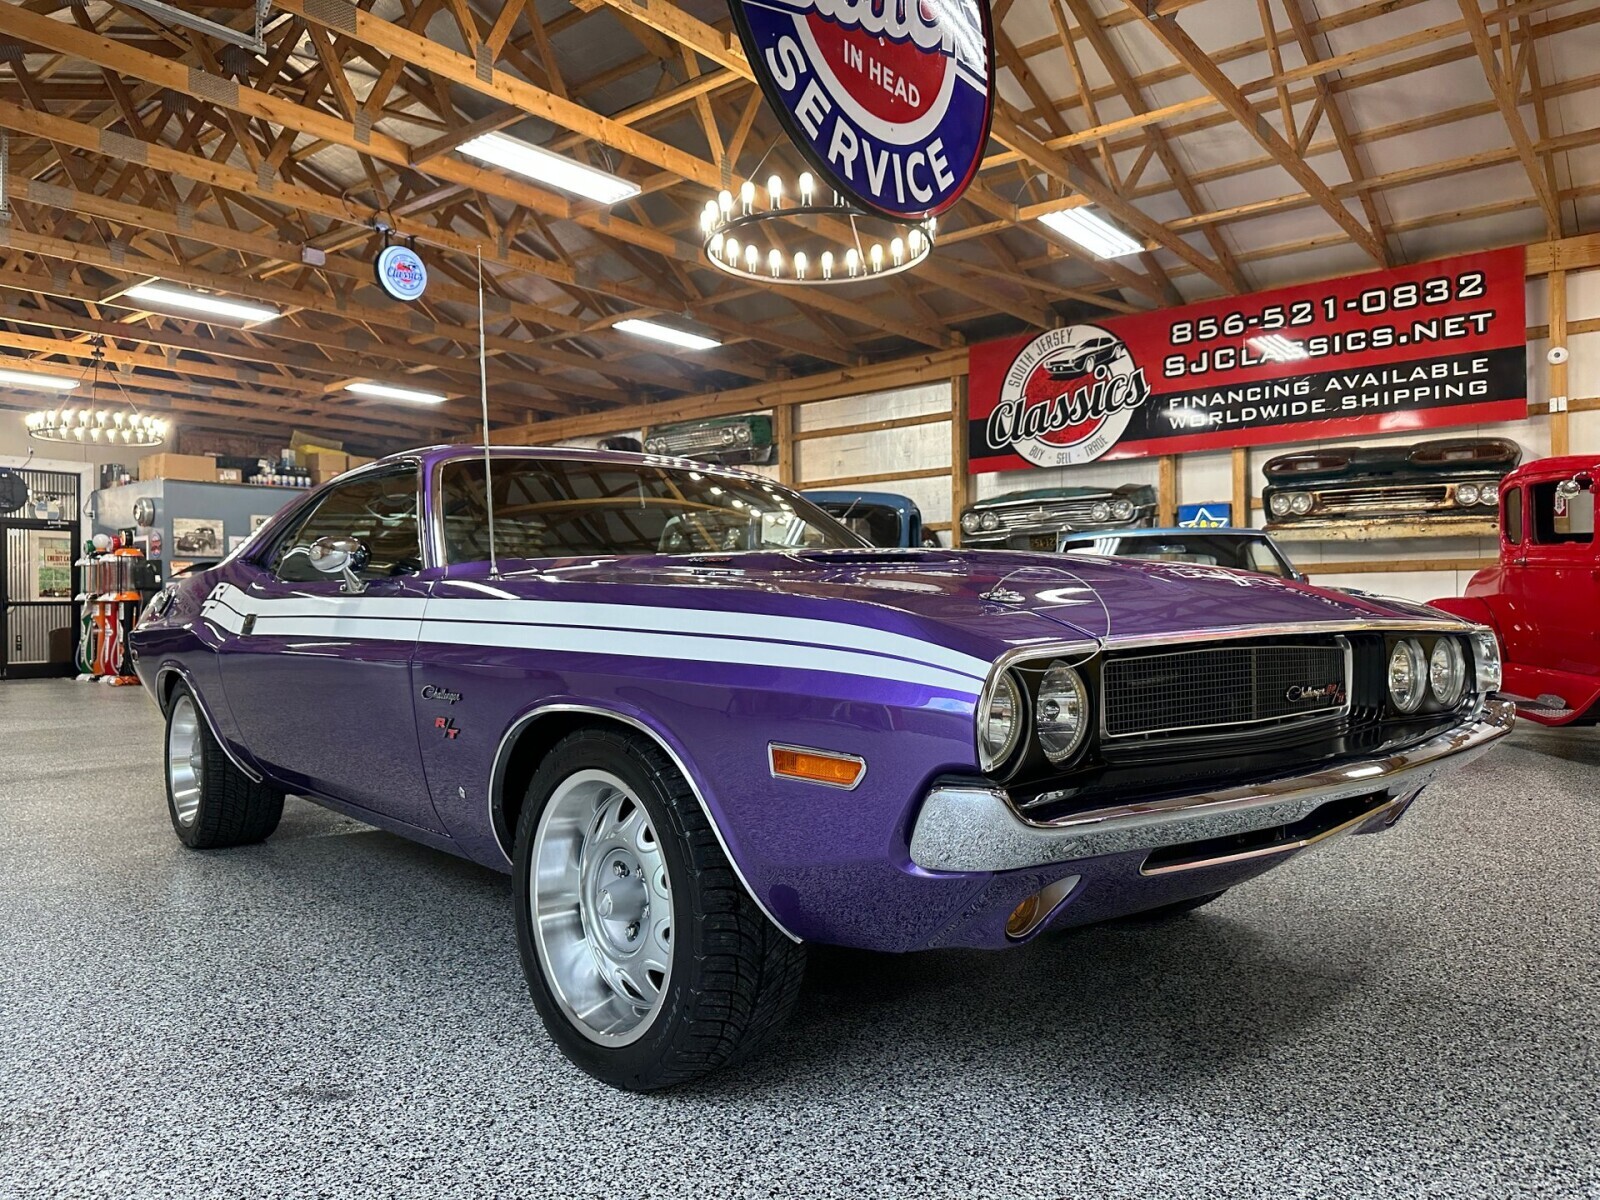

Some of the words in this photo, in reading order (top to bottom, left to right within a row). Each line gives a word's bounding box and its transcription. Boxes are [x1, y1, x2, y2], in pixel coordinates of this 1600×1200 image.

[843, 38, 863, 74] IN
[869, 57, 921, 108] HEAD
[765, 35, 955, 203] SERVICE
[1171, 272, 1485, 344] 856-521-0832
[1008, 352, 1035, 388] SOUTH
[1033, 328, 1073, 356] JERSEY
[1169, 381, 1310, 411] FINANCING
[1324, 357, 1489, 392] AVAILABLE
[986, 364, 1151, 449] Classics
[1169, 398, 1326, 430] WORLDWIDE
[1341, 379, 1488, 410] SHIPPING
[1028, 445, 1045, 460] BUY
[1056, 451, 1072, 464] SELL
[1084, 434, 1109, 457] TRADE
[421, 684, 462, 705] Challenger
[434, 716, 460, 739] R/T
